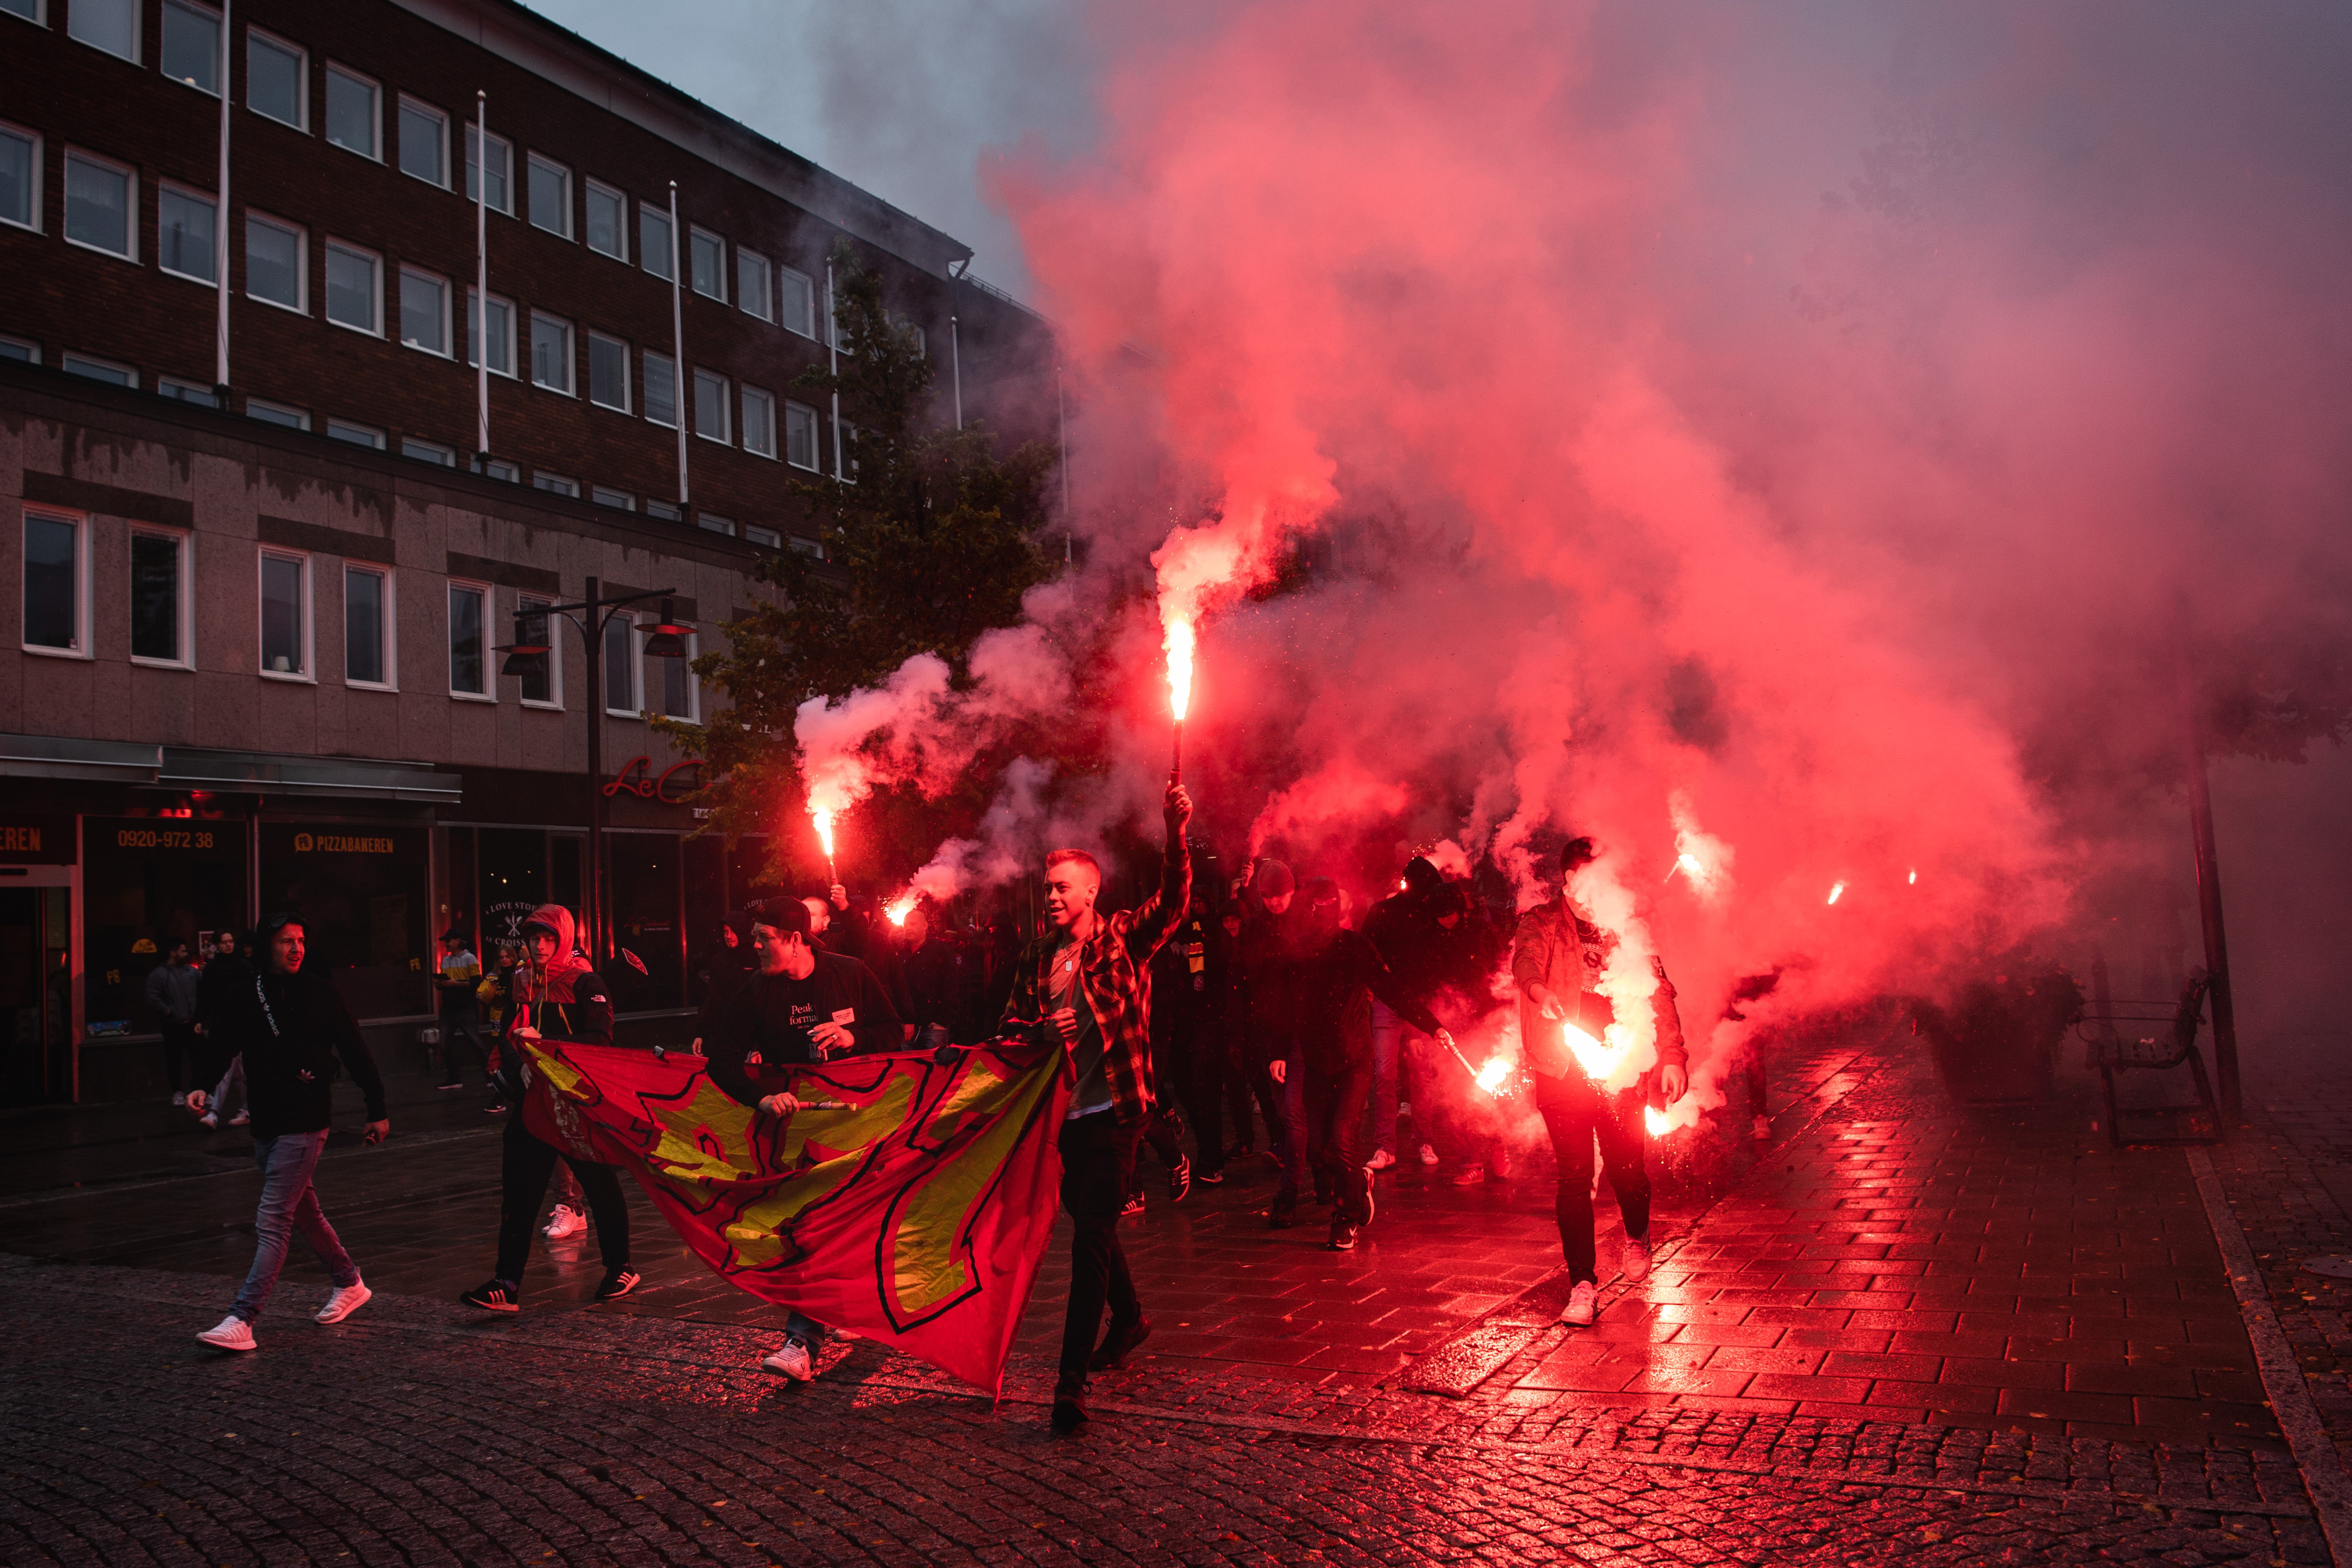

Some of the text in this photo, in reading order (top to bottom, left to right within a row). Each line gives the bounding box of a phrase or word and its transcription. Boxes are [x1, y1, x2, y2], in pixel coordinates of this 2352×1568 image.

[117, 830, 214, 849] 0920-972 38
[317, 835, 394, 853] PIZZABAKEREN
[490, 902, 512, 913] LOVE
[410, 958, 421, 971] PB
[106, 969, 121, 985] PB
[790, 1003, 813, 1015] Peak
[789, 1014, 818, 1025] forma
